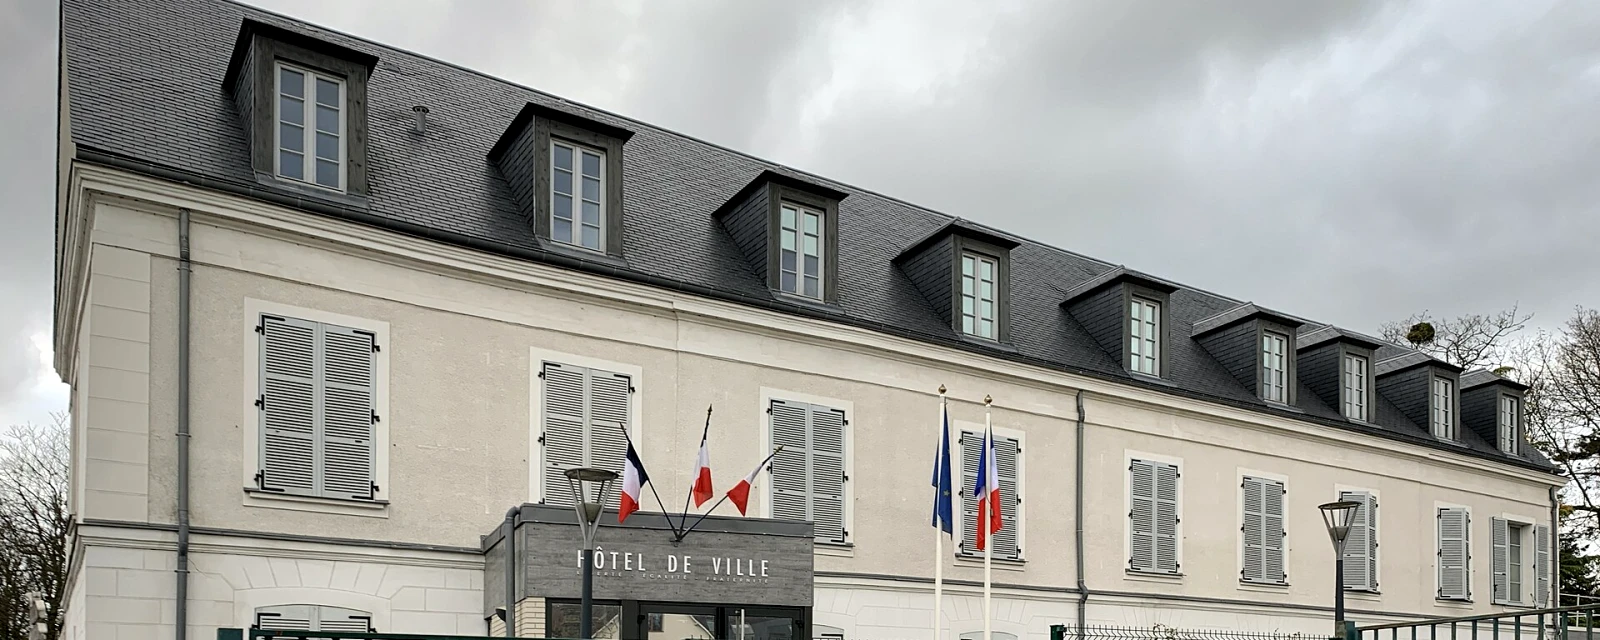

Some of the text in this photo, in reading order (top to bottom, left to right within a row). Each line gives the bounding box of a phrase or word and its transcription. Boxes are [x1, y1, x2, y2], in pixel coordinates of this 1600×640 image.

[577, 546, 769, 577] HÔTEL DE VILLE
